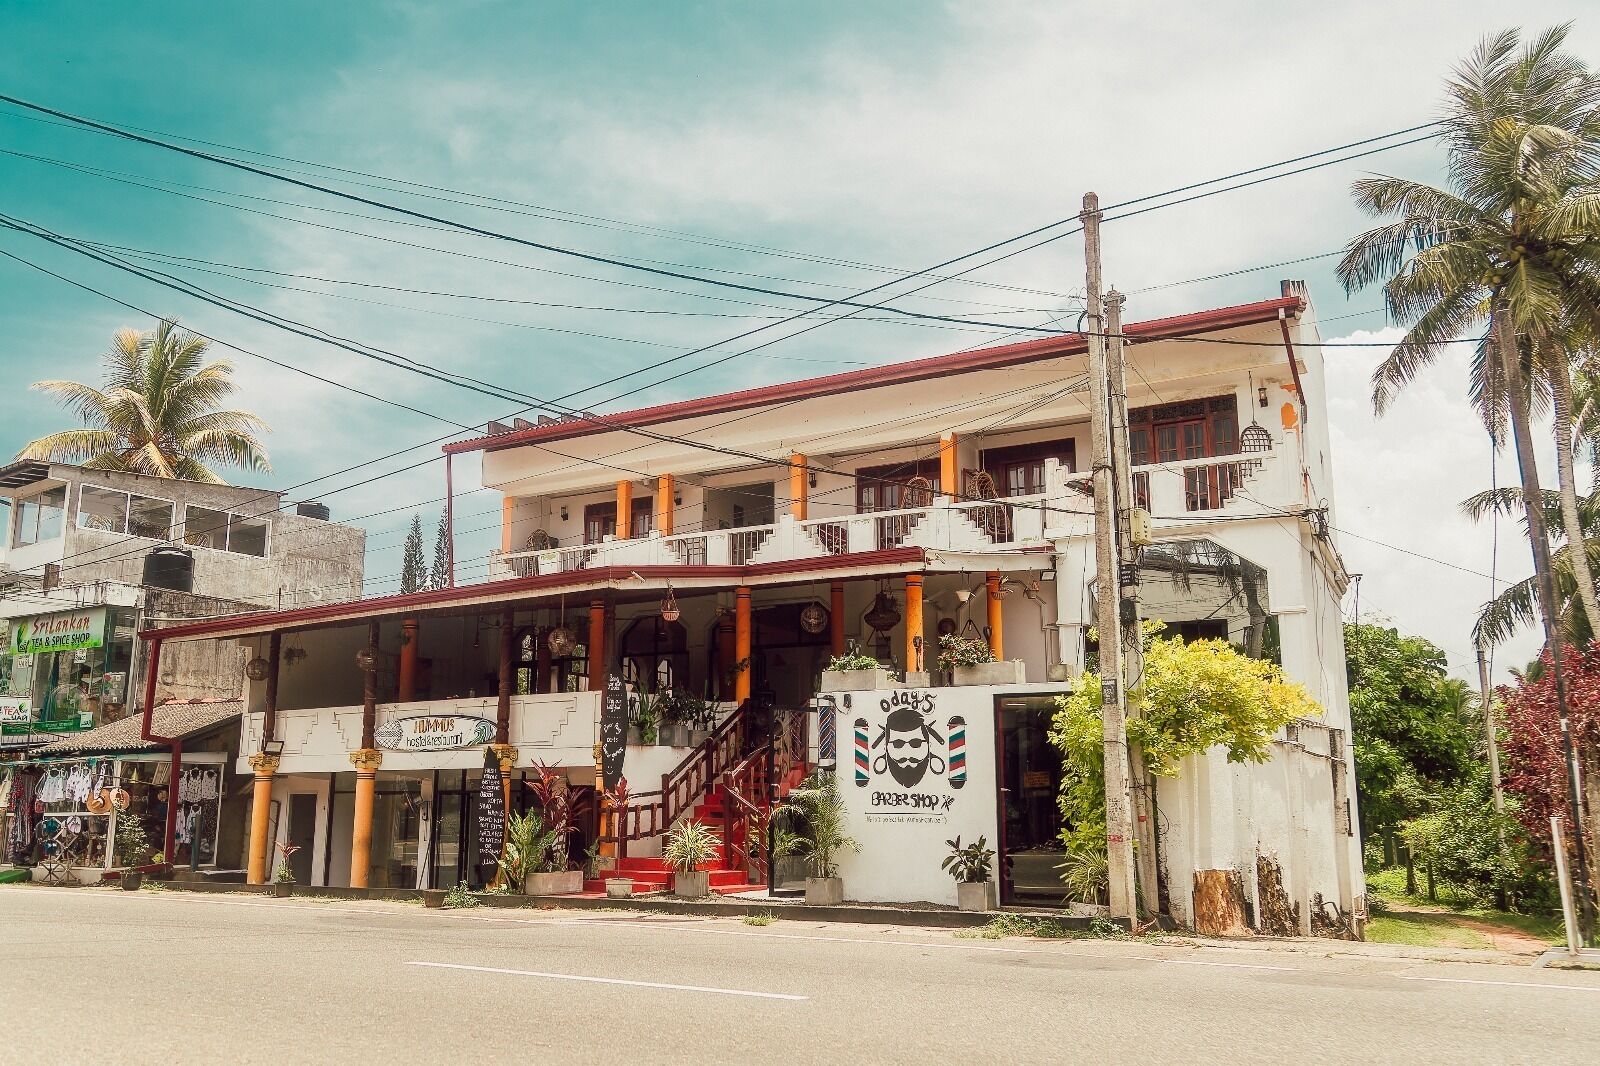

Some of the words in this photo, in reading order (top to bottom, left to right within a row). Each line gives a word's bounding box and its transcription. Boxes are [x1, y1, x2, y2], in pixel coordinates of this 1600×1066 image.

[32, 638, 43, 648] TEA
[45, 637, 51, 647] &
[51, 635, 71, 646] SPICE
[71, 632, 90, 645] SHOP
[3, 708, 20, 716] TEA
[413, 718, 455, 734] HUMMUS
[871, 791, 910, 807] BARBER
[910, 793, 940, 811] SHOP
